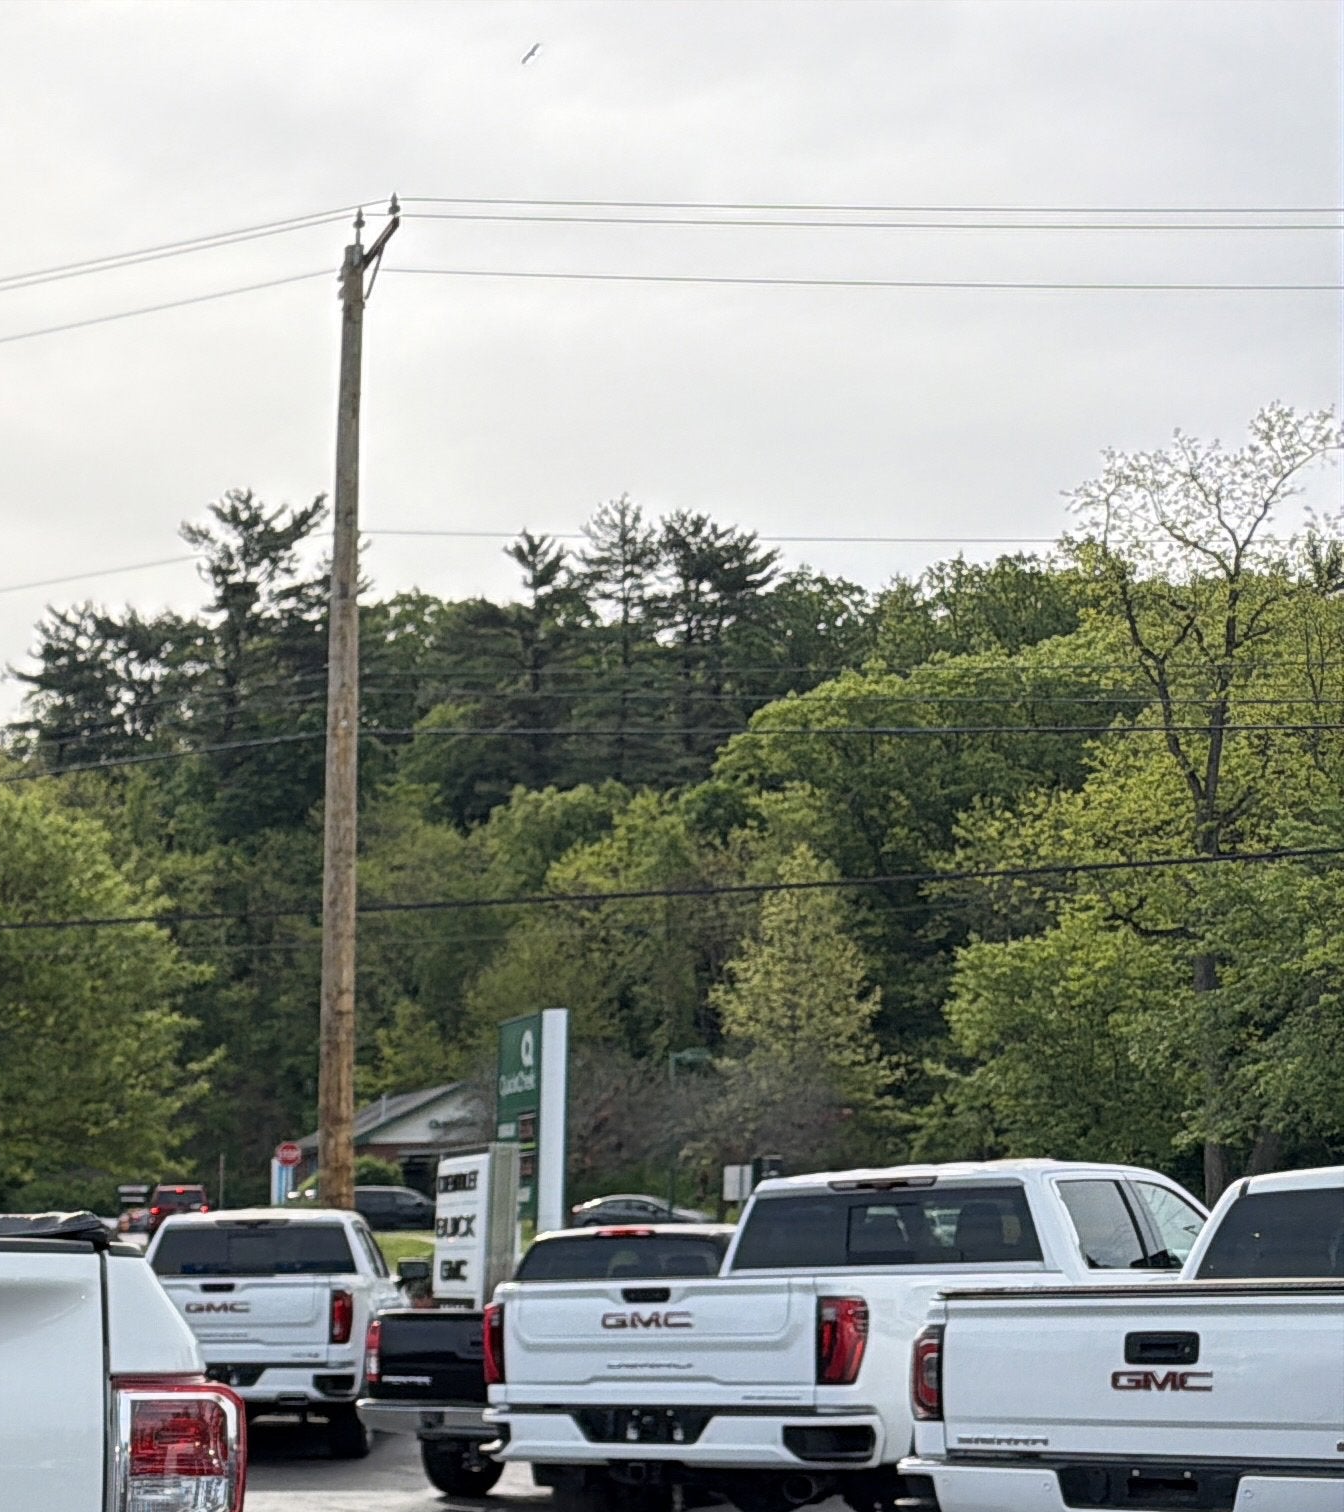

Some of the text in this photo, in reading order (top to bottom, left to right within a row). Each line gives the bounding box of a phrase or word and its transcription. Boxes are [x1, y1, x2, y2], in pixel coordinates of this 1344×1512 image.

[185, 1302, 251, 1313] GMC
[601, 1311, 694, 1330] GMC
[1111, 1370, 1213, 1392] GMC
